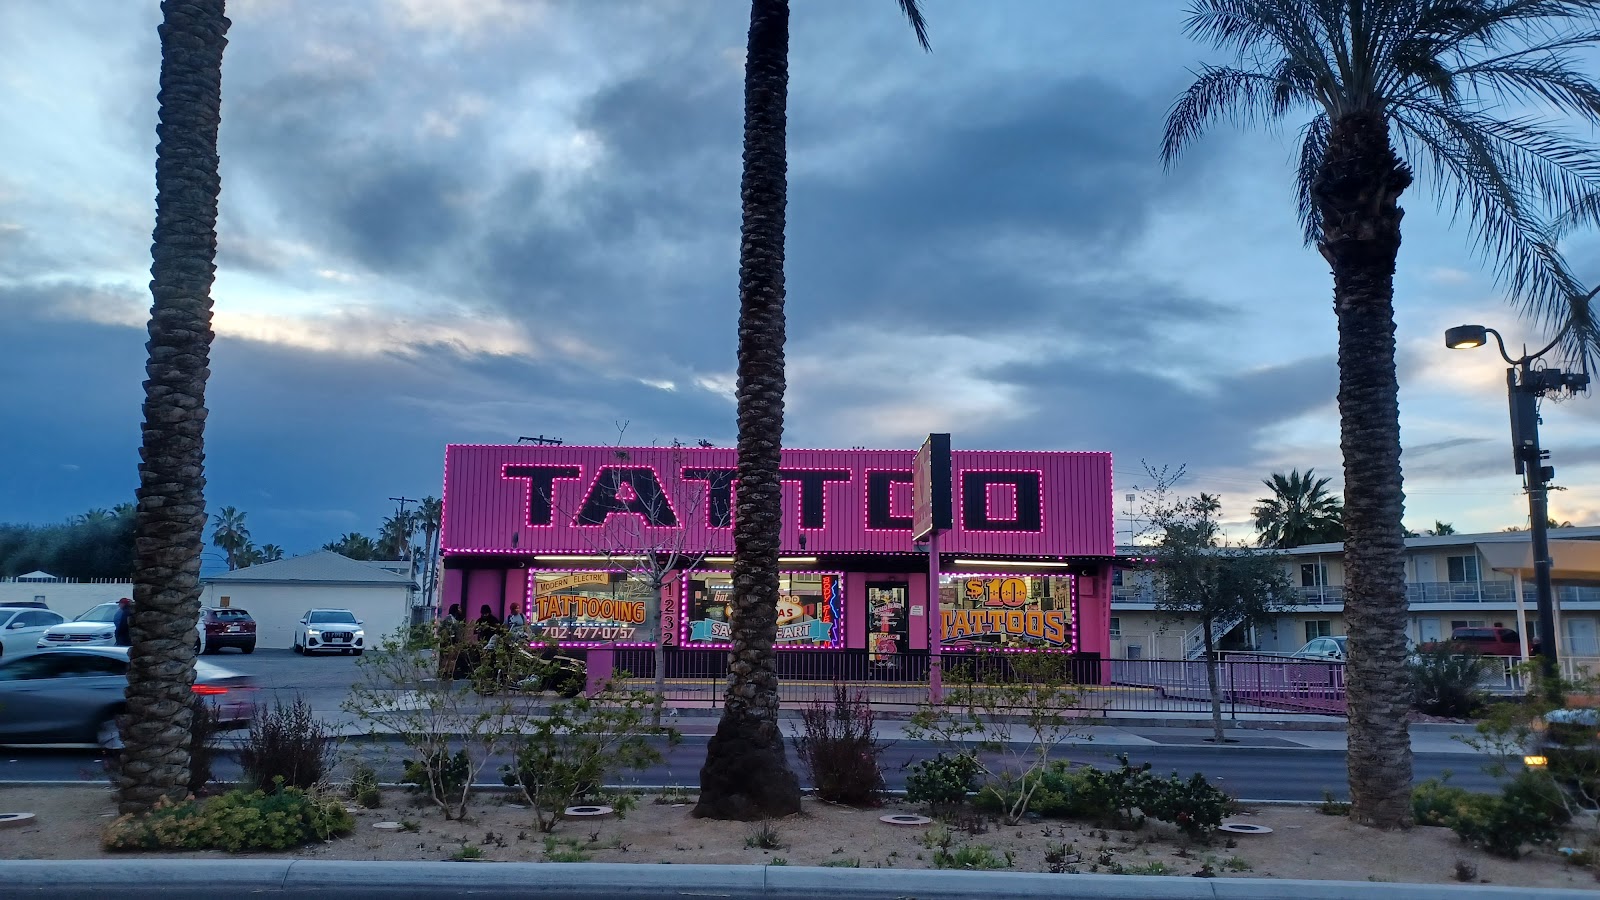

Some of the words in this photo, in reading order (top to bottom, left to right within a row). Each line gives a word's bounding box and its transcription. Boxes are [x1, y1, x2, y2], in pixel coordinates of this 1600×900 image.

[502, 464, 1044, 534] TATTOO
[540, 580, 568, 590] MODERN
[573, 573, 603, 583] ELECTRIC
[965, 576, 1028, 608] $10
[535, 595, 646, 624] TATTOOING
[775, 624, 811, 639] EART
[939, 609, 1066, 645] TATTOOS
